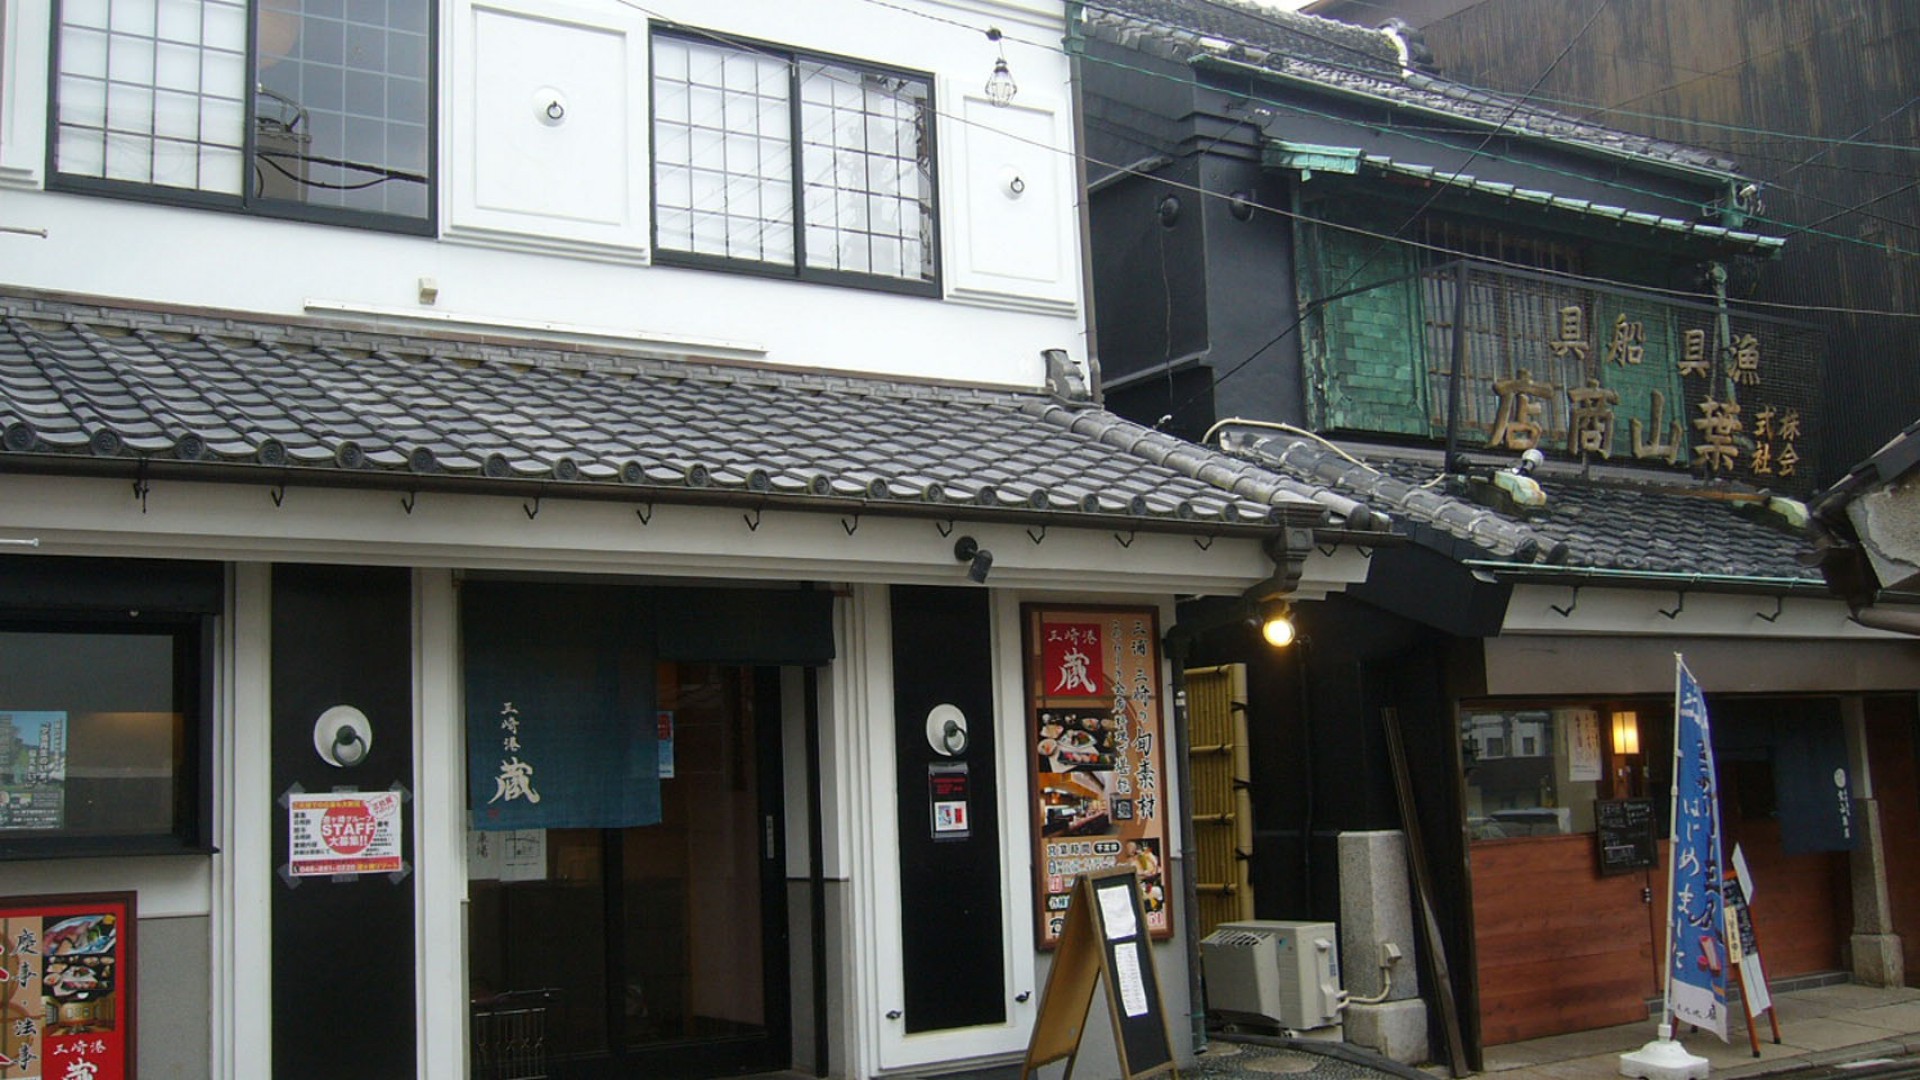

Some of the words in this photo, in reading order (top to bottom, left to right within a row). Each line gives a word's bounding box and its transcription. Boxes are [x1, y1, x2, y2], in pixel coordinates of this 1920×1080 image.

[1484, 367, 1743, 472] 葉山商店
[1047, 627, 1098, 646] 三崎港
[1053, 647, 1097, 694] 蔵
[501, 701, 521, 752] 三崎港
[488, 756, 541, 805] 蔵
[322, 822, 375, 836] STAFF
[10, 928, 38, 1071] 慶事・法事
[53, 1039, 107, 1056] 三崎港
